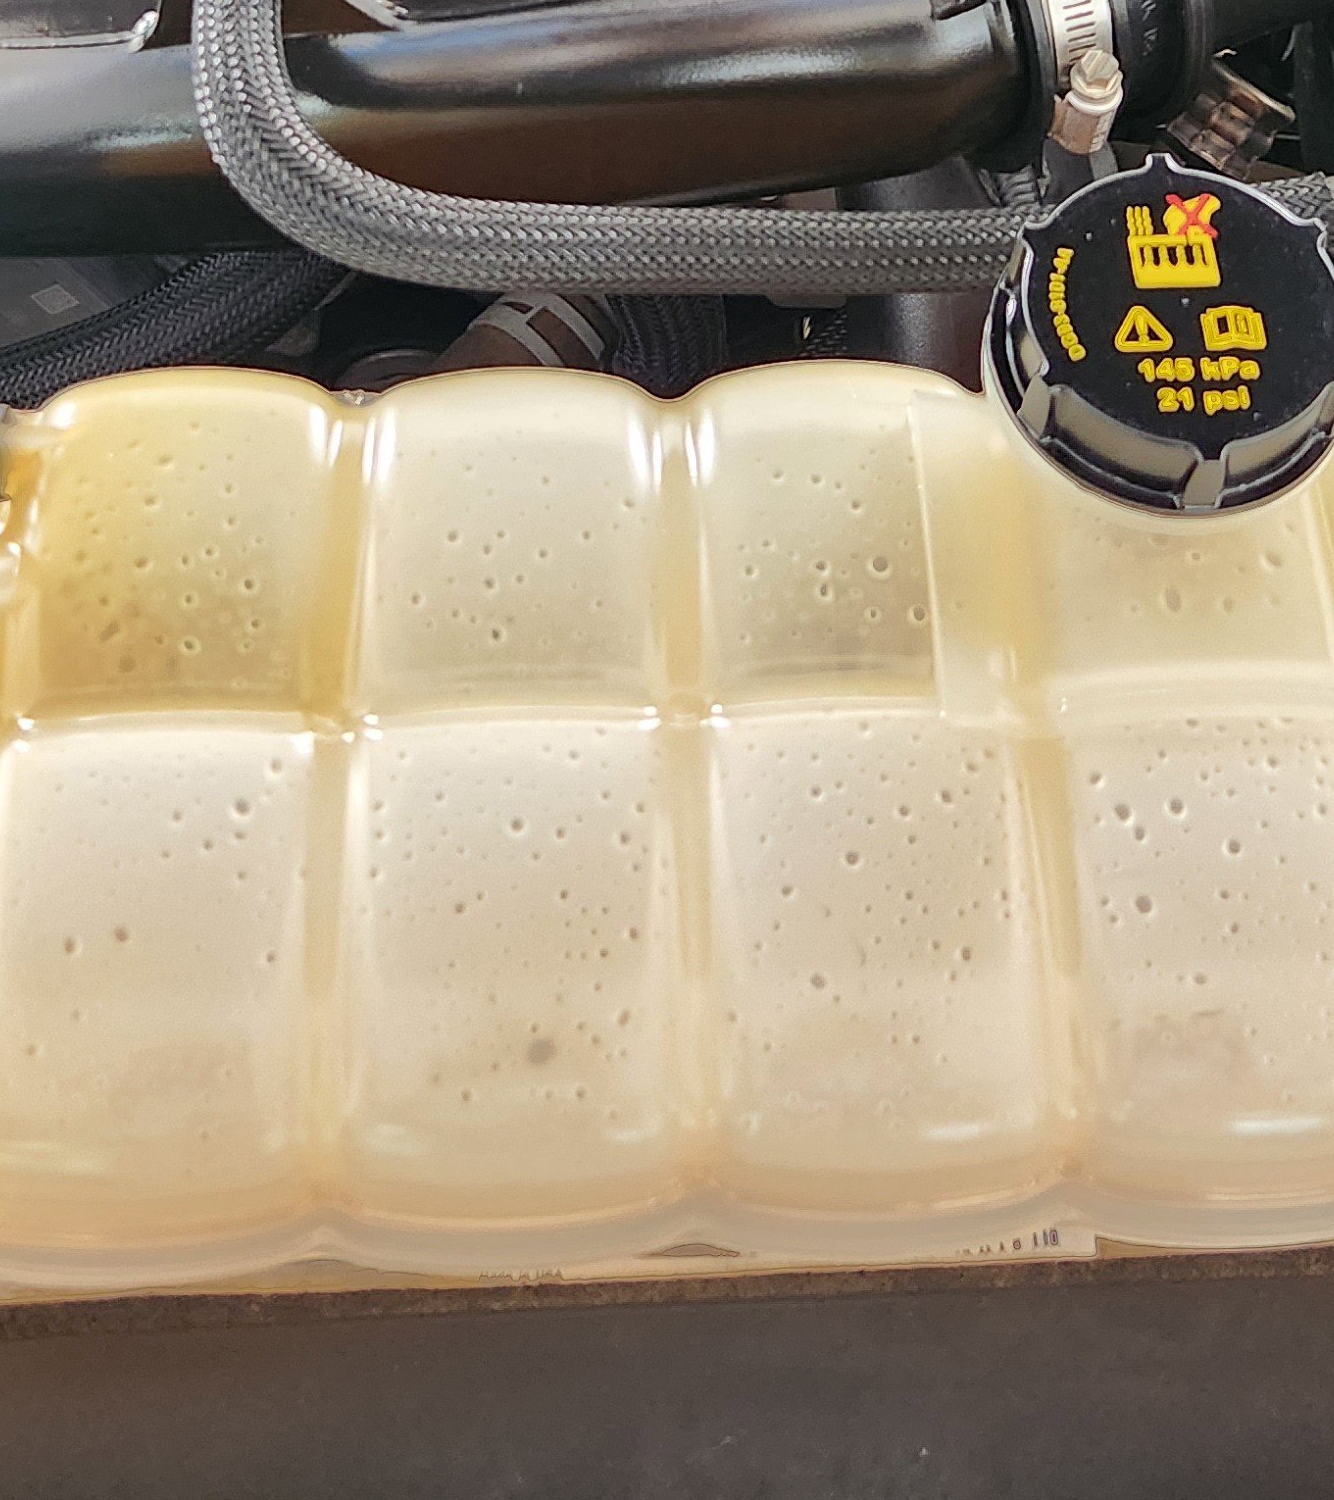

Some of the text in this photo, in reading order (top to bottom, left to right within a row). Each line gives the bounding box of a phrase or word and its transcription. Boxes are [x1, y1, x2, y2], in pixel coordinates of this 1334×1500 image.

[1137, 356, 1260, 383] 145 kPa
[1156, 385, 1251, 415] 21 psi
